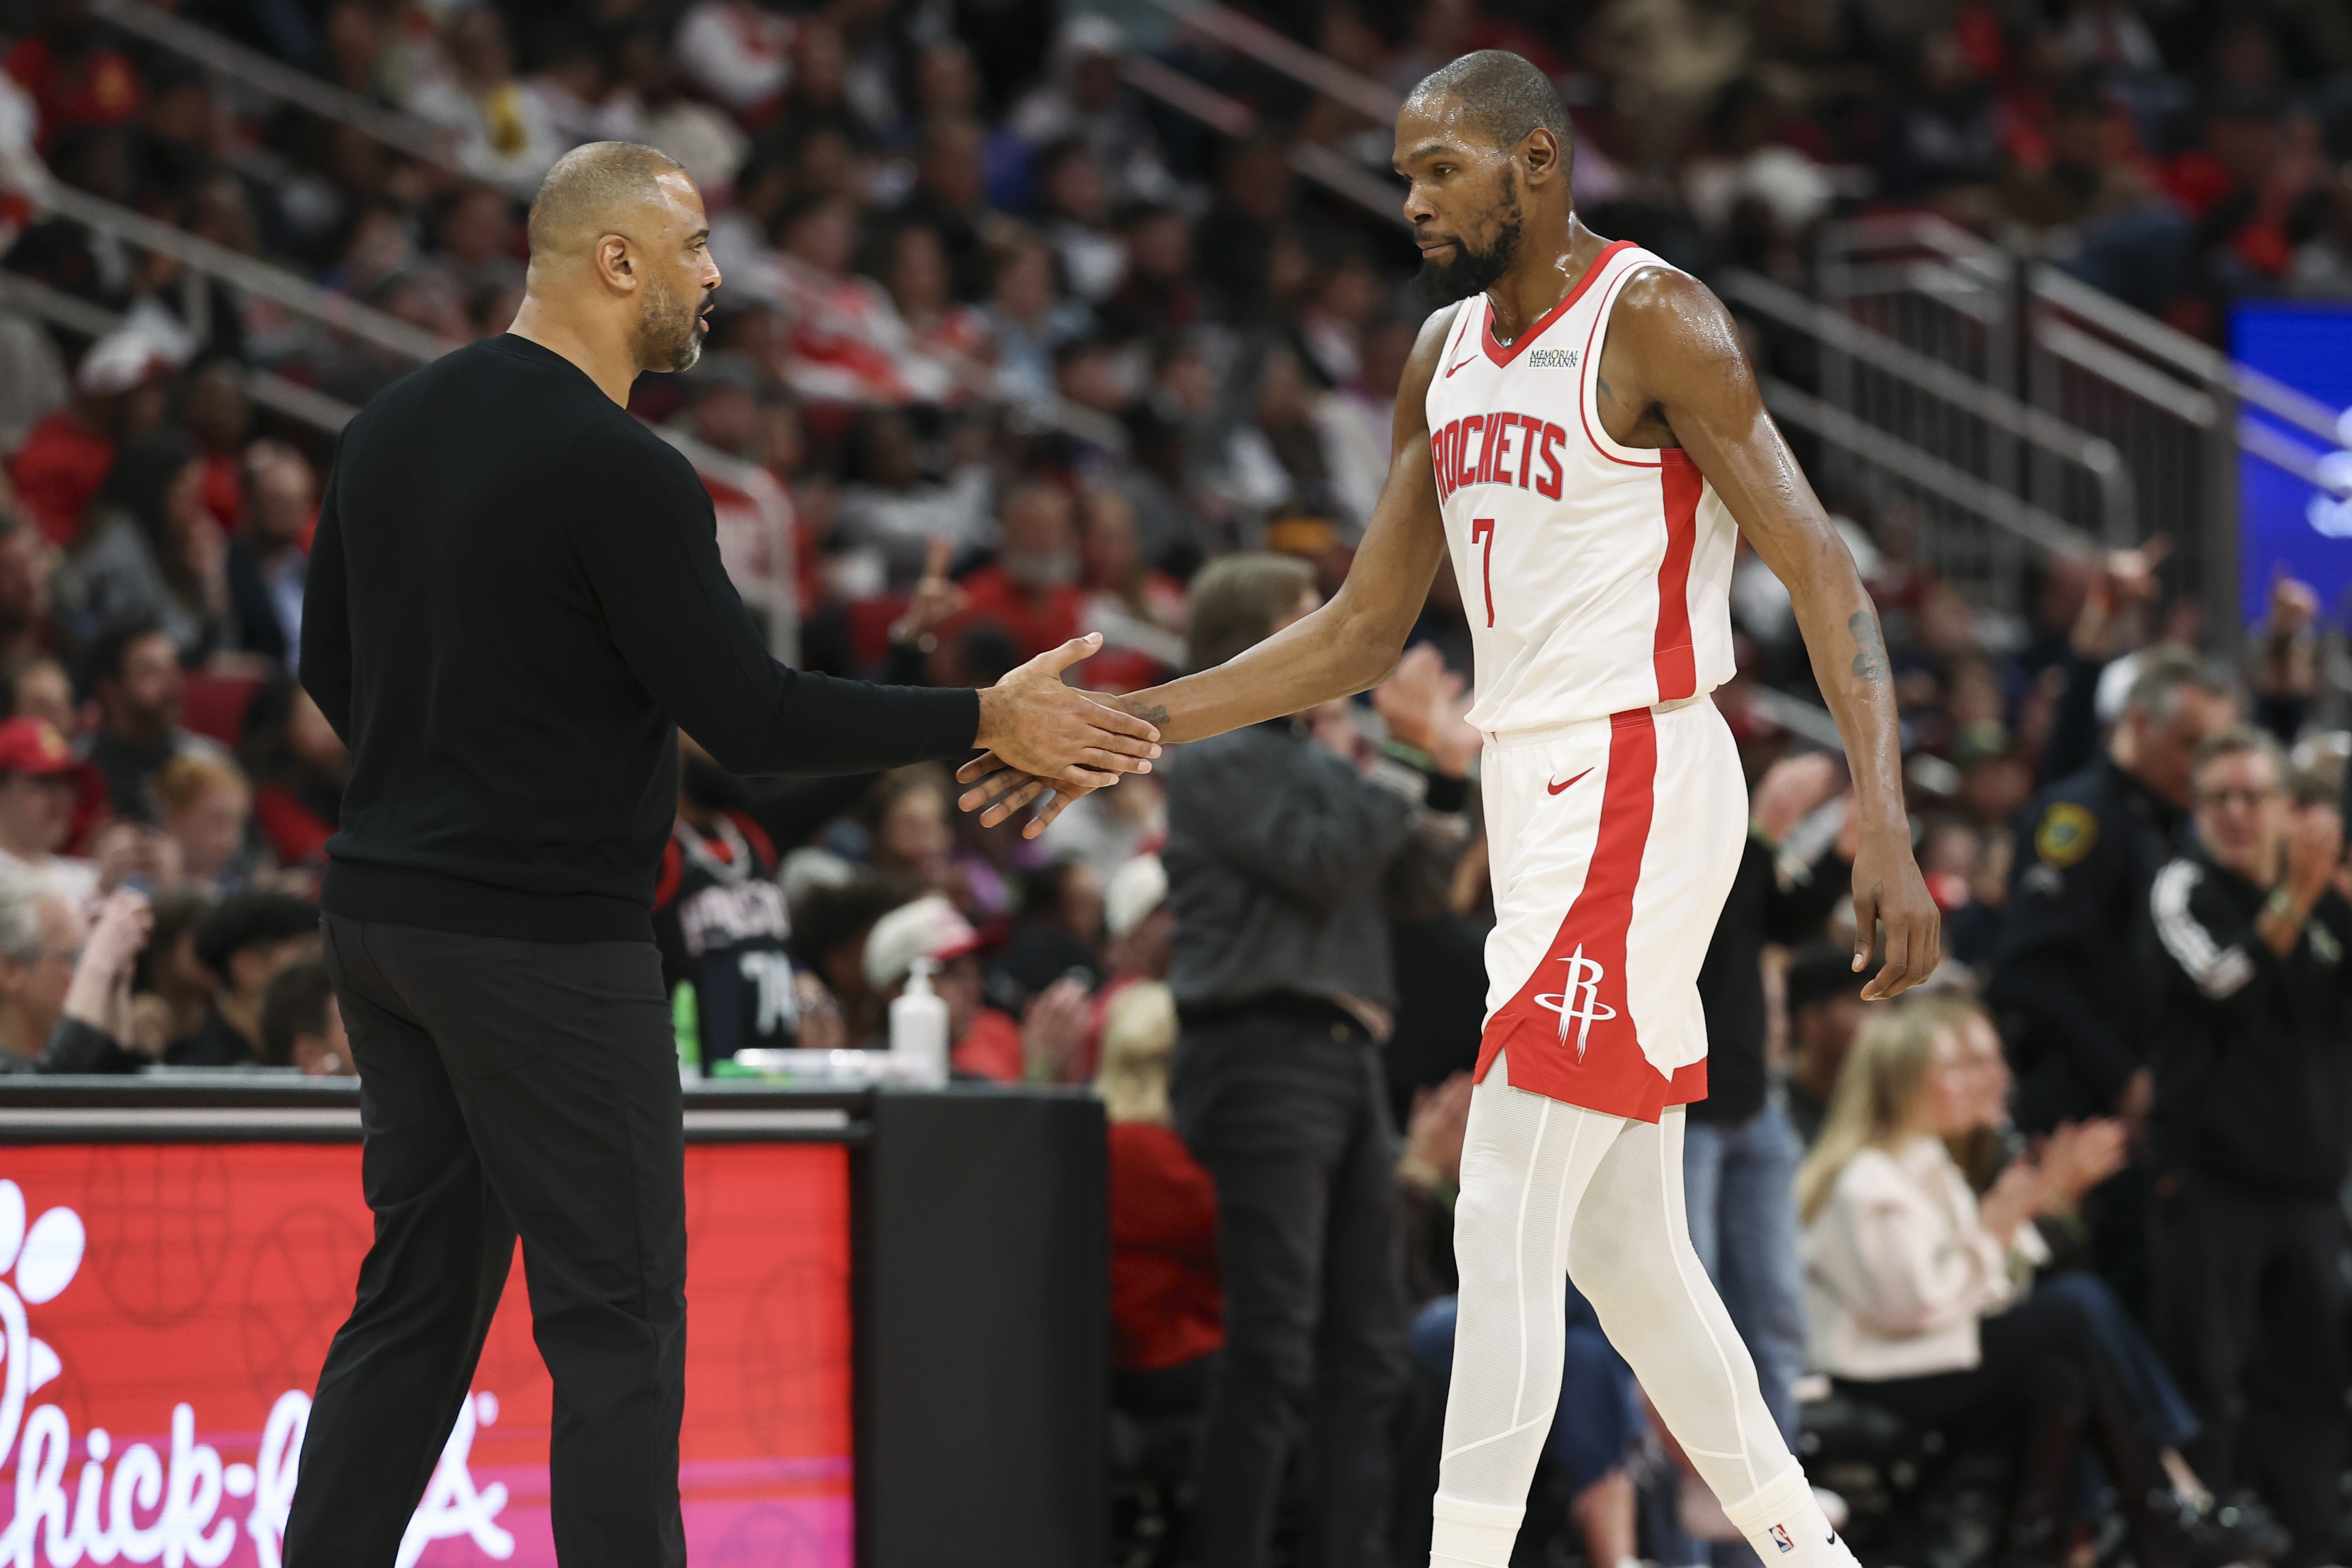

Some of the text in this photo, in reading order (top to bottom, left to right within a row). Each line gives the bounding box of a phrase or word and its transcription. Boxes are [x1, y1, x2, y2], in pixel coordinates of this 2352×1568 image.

[1529, 358, 1577, 367] HERMANN
[1530, 349, 1579, 360] MEMORIAL
[1430, 411, 1567, 509] ROCKETS
[1472, 518, 1494, 628] 7
